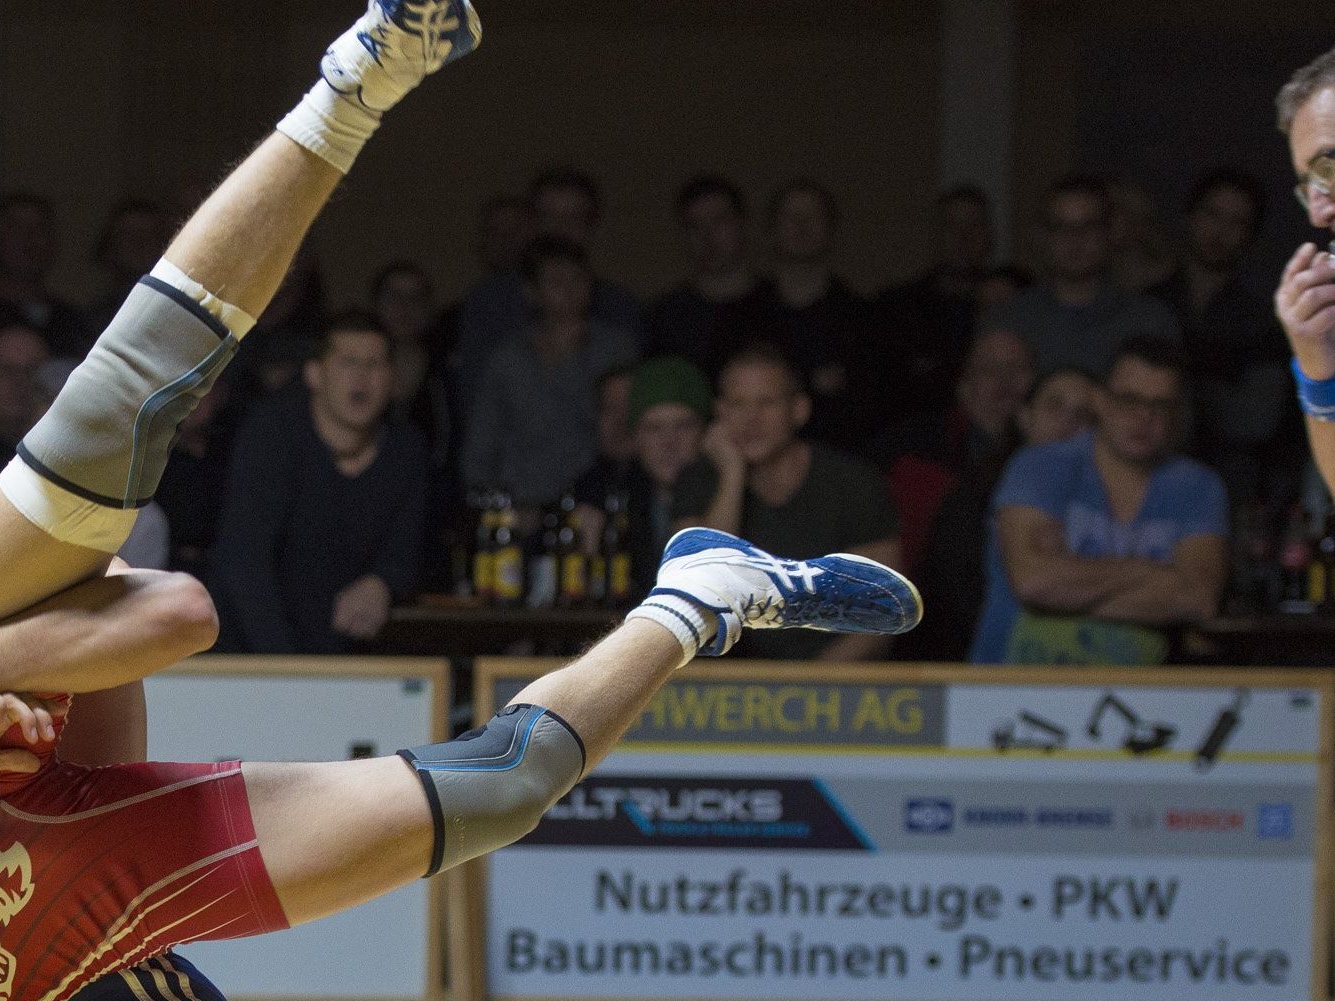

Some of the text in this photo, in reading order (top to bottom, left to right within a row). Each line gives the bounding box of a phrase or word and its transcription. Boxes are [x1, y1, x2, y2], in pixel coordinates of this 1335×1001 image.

[853, 689, 923, 735] AG
[595, 869, 1180, 931] Nutzfahrzeuge PKW
[504, 928, 1290, 985] Baumaschinen Pneuservice
